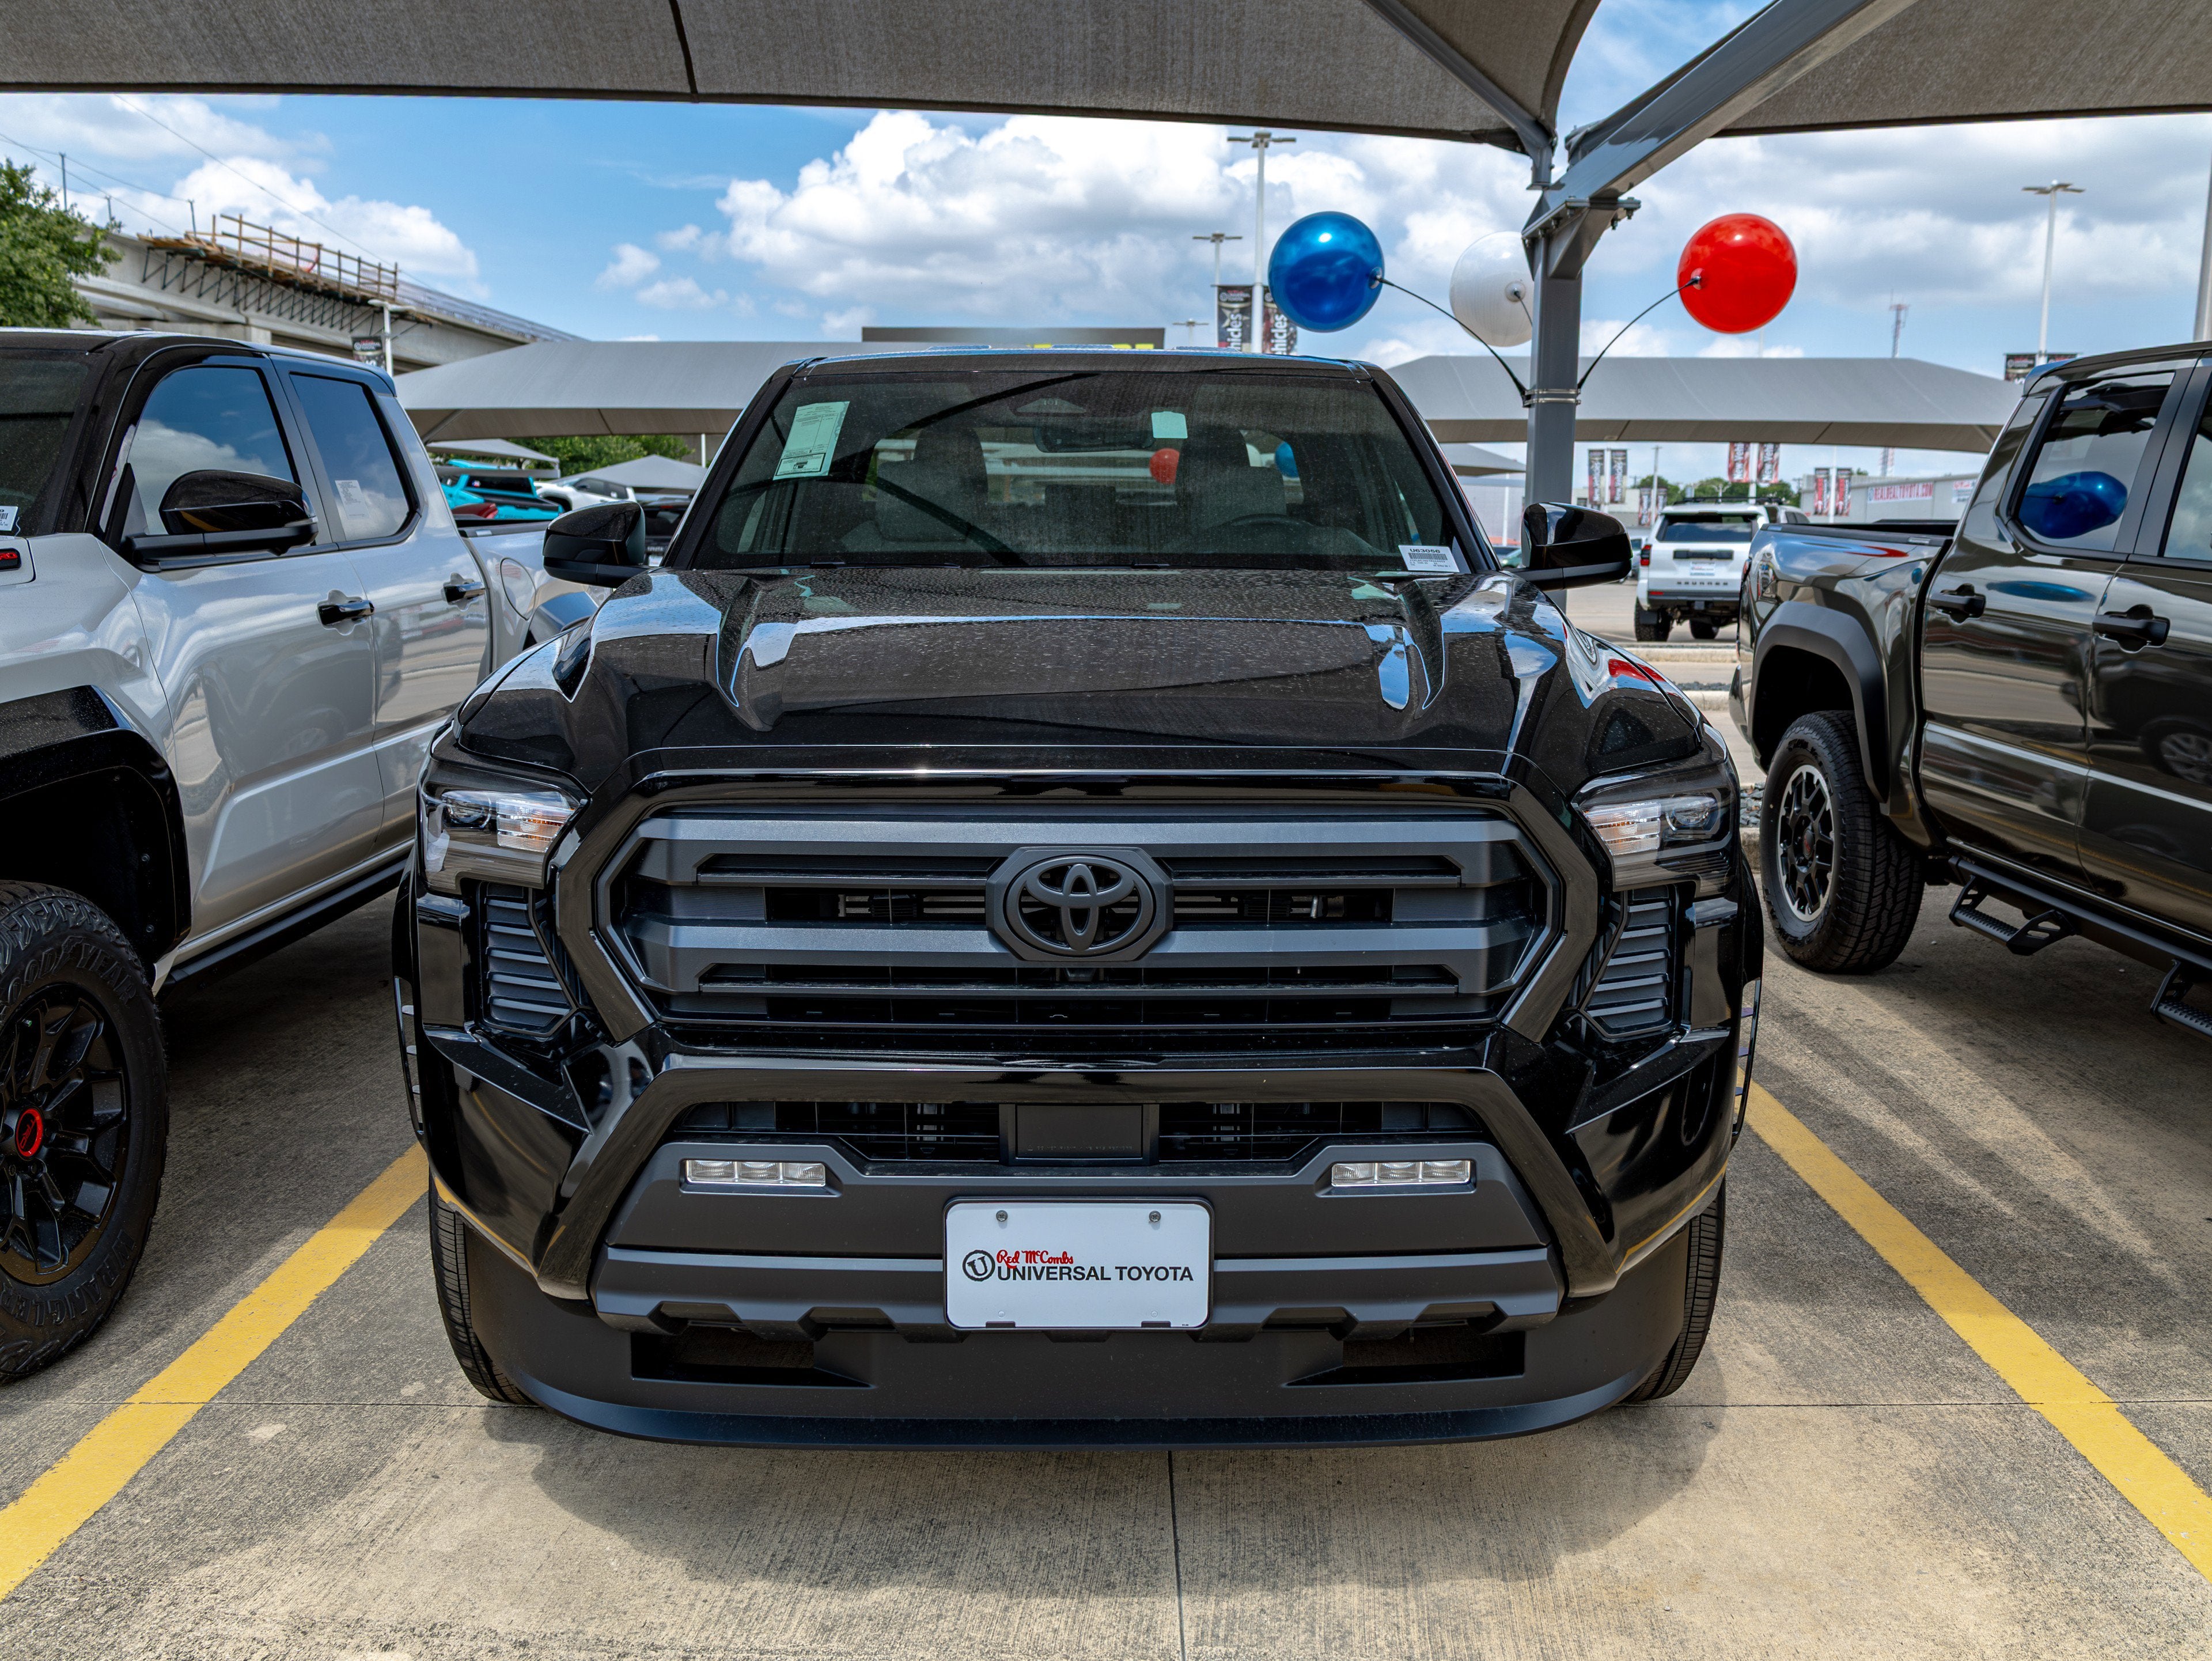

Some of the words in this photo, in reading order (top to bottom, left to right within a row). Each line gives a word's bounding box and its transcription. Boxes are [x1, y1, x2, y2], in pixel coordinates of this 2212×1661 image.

[1733, 463, 1744, 480] New
[1762, 463, 1772, 480] New
[996, 1250, 1020, 1269] Red
[1021, 1250, 1074, 1265] McCombs
[997, 1265, 1112, 1281] UNIVERSAL
[1114, 1265, 1194, 1281] TOYOTA
